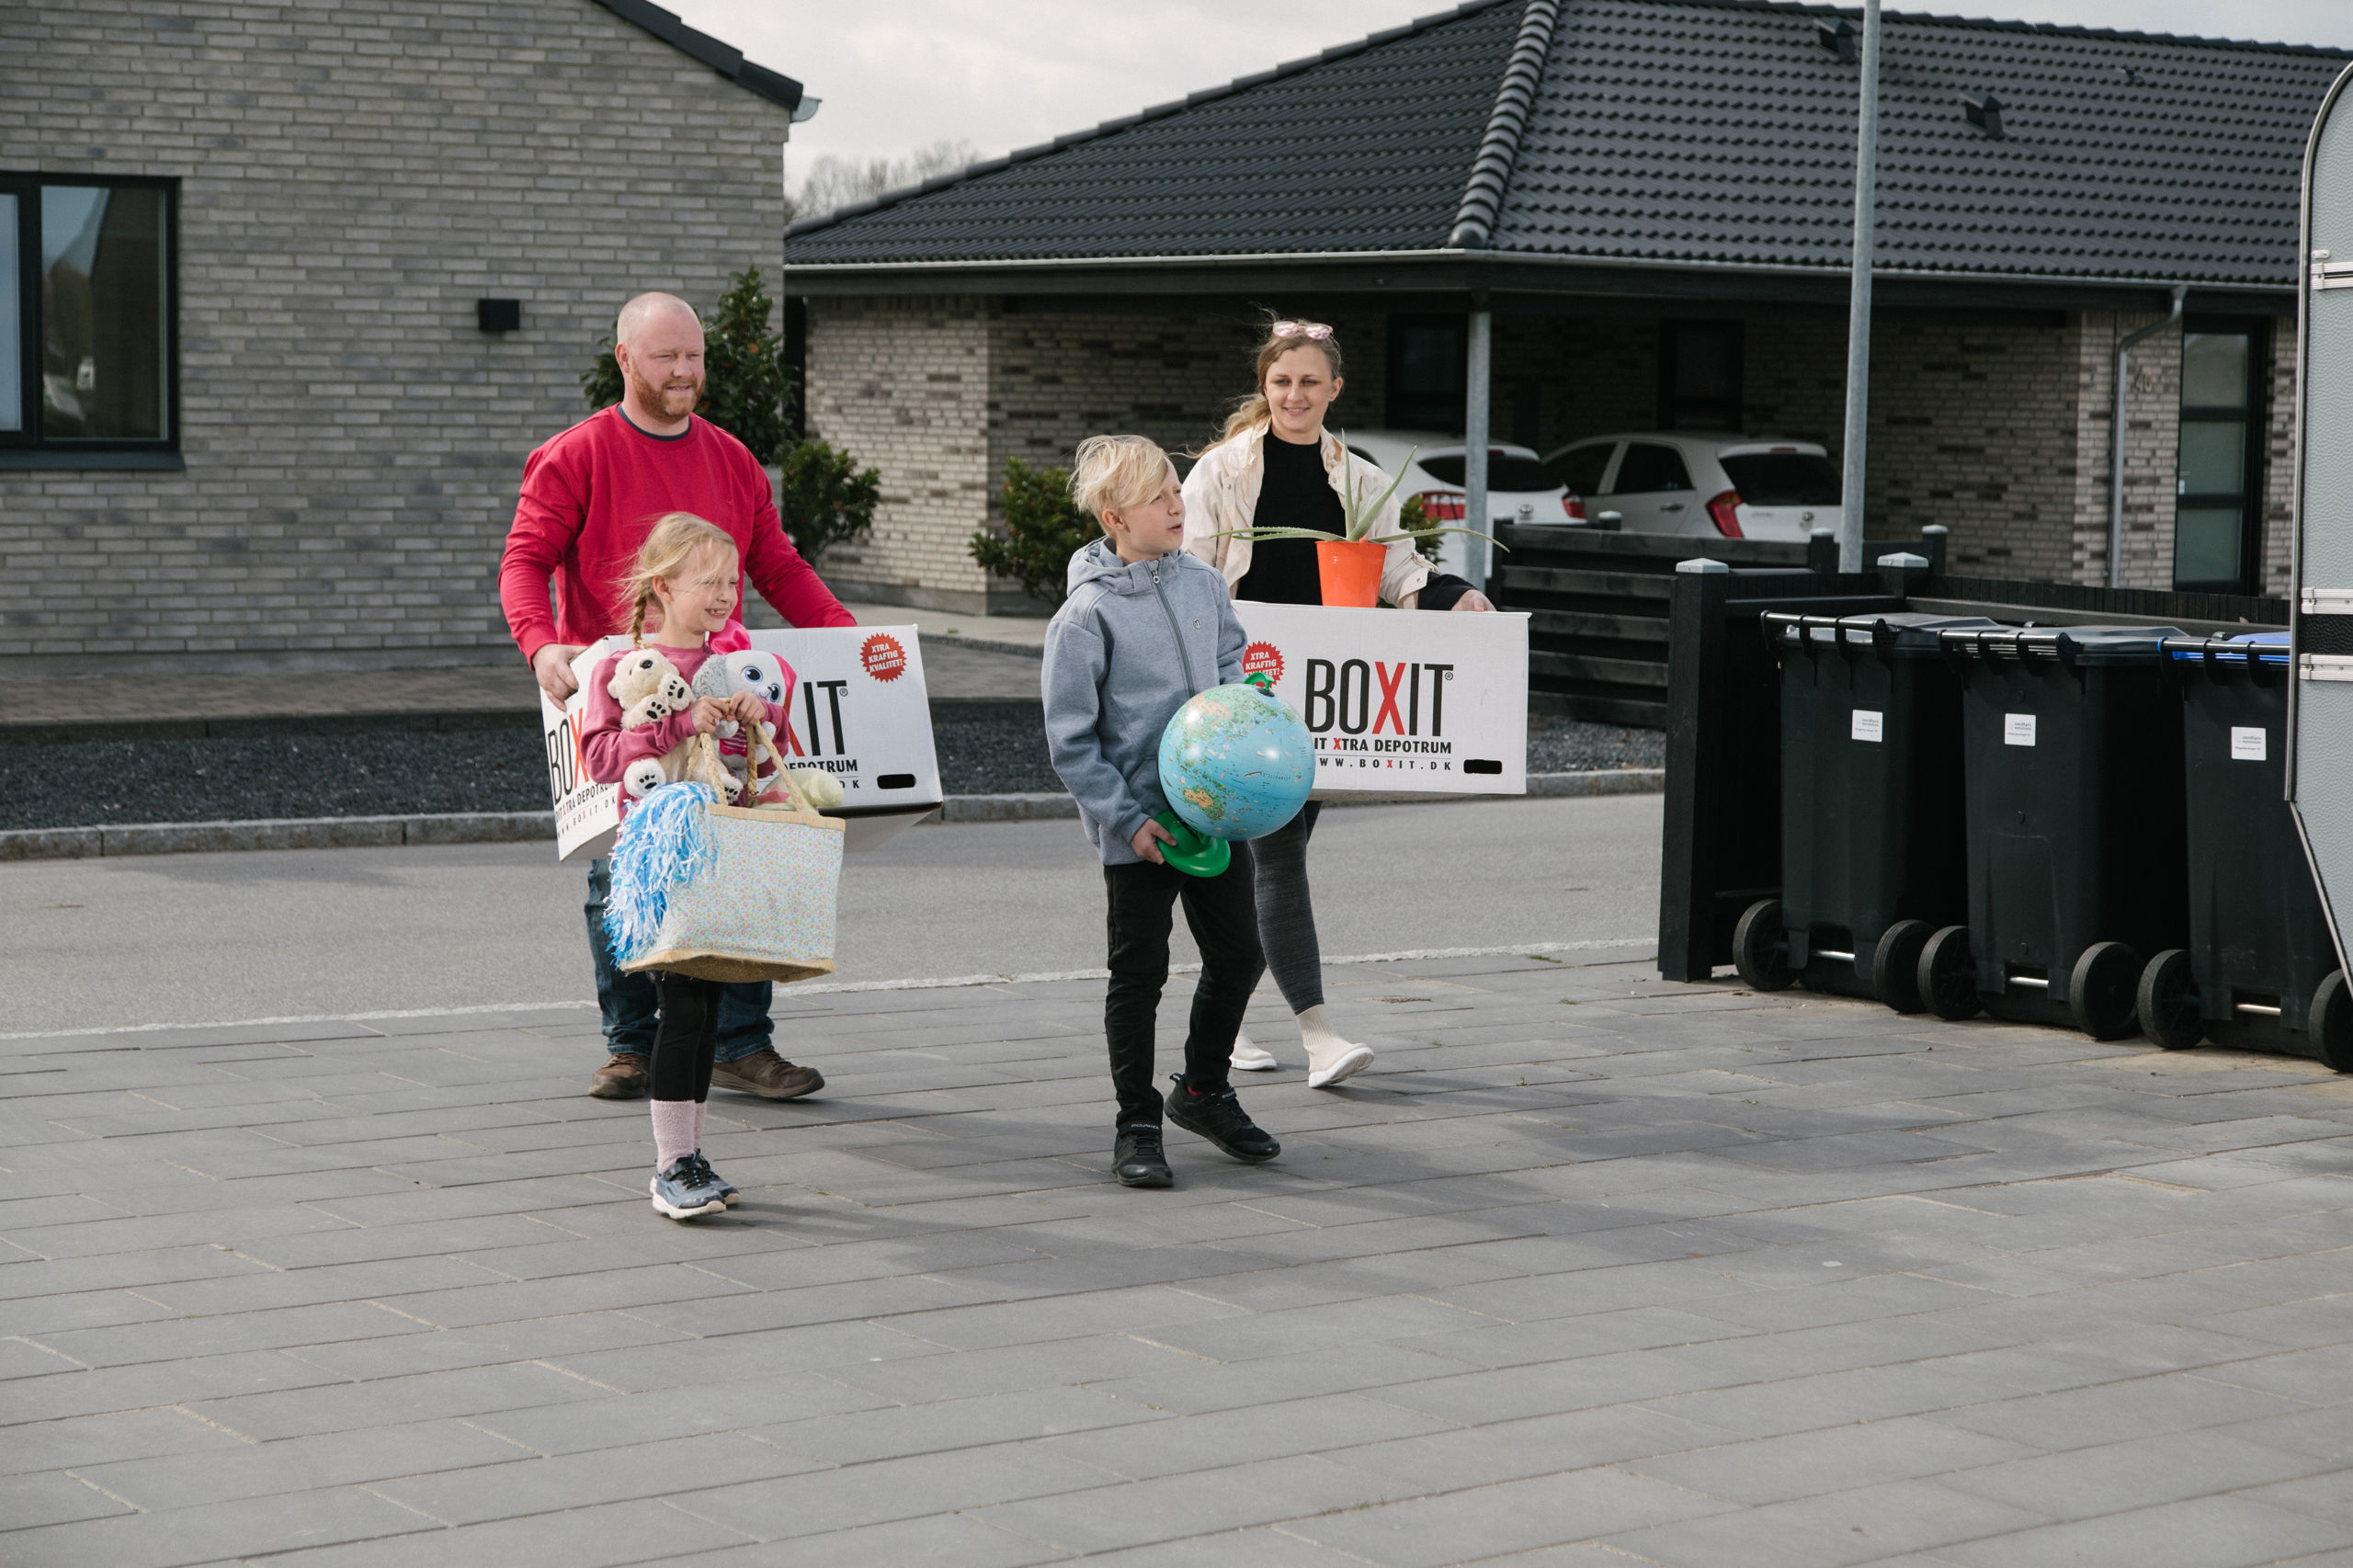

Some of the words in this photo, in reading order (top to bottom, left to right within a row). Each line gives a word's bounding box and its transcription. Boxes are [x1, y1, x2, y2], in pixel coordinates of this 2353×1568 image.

[872, 643, 890, 653] XTRA
[869, 651, 898, 663] KRAFTIG
[1250, 652, 1269, 661] XTRA
[870, 659, 903, 672] KVALITET!
[1245, 660, 1277, 670] KRAFTIG
[1304, 658, 1454, 737] BOXIT
[1313, 737, 1327, 750] IT
[1333, 737, 1369, 752] XTRA
[1374, 740, 1451, 755] DEPOTRUM
[547, 707, 589, 805] BOX
[1319, 757, 1451, 771] WW.BOXIT.DK
